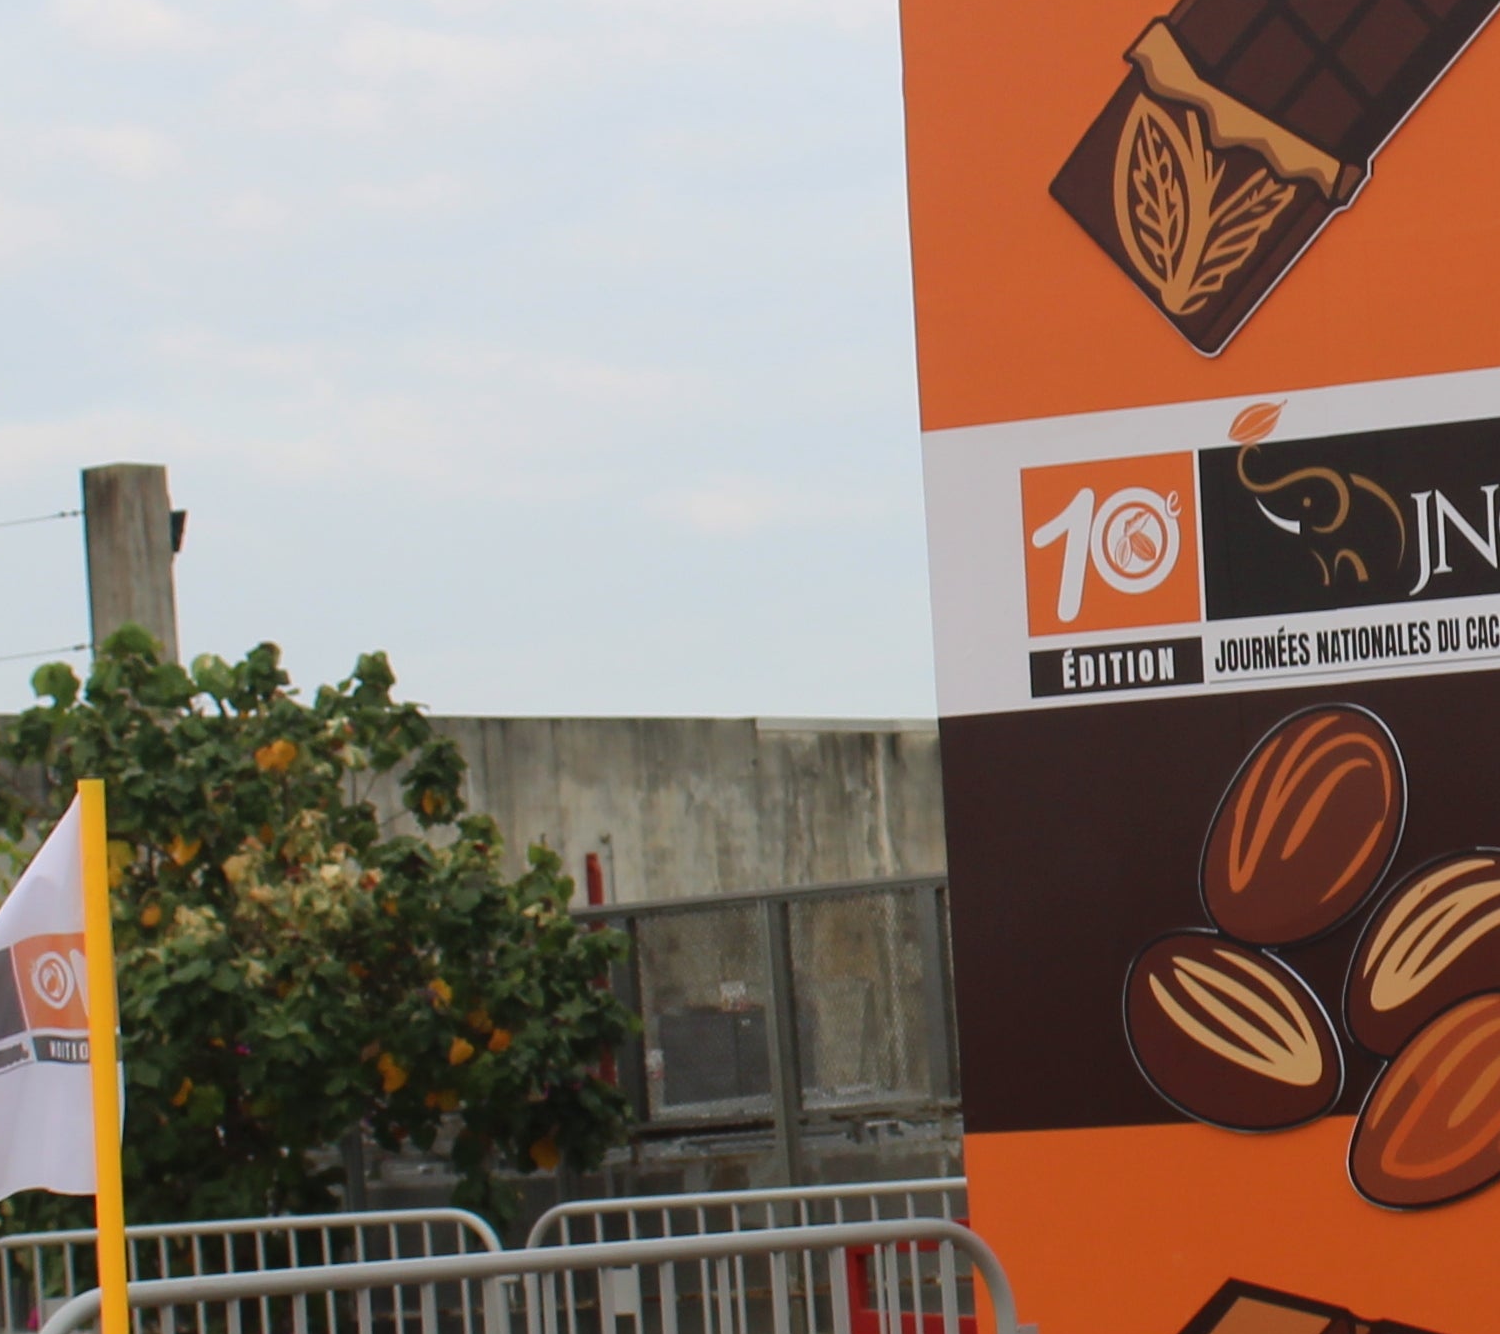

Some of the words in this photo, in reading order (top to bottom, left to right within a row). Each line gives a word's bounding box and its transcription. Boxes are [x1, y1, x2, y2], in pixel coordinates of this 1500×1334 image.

[1061, 646, 1176, 690] ÉDITION
[1214, 625, 1311, 674] JOURNÉES
[1316, 620, 1432, 666] NATIONALES
[1437, 618, 1461, 653] DU
